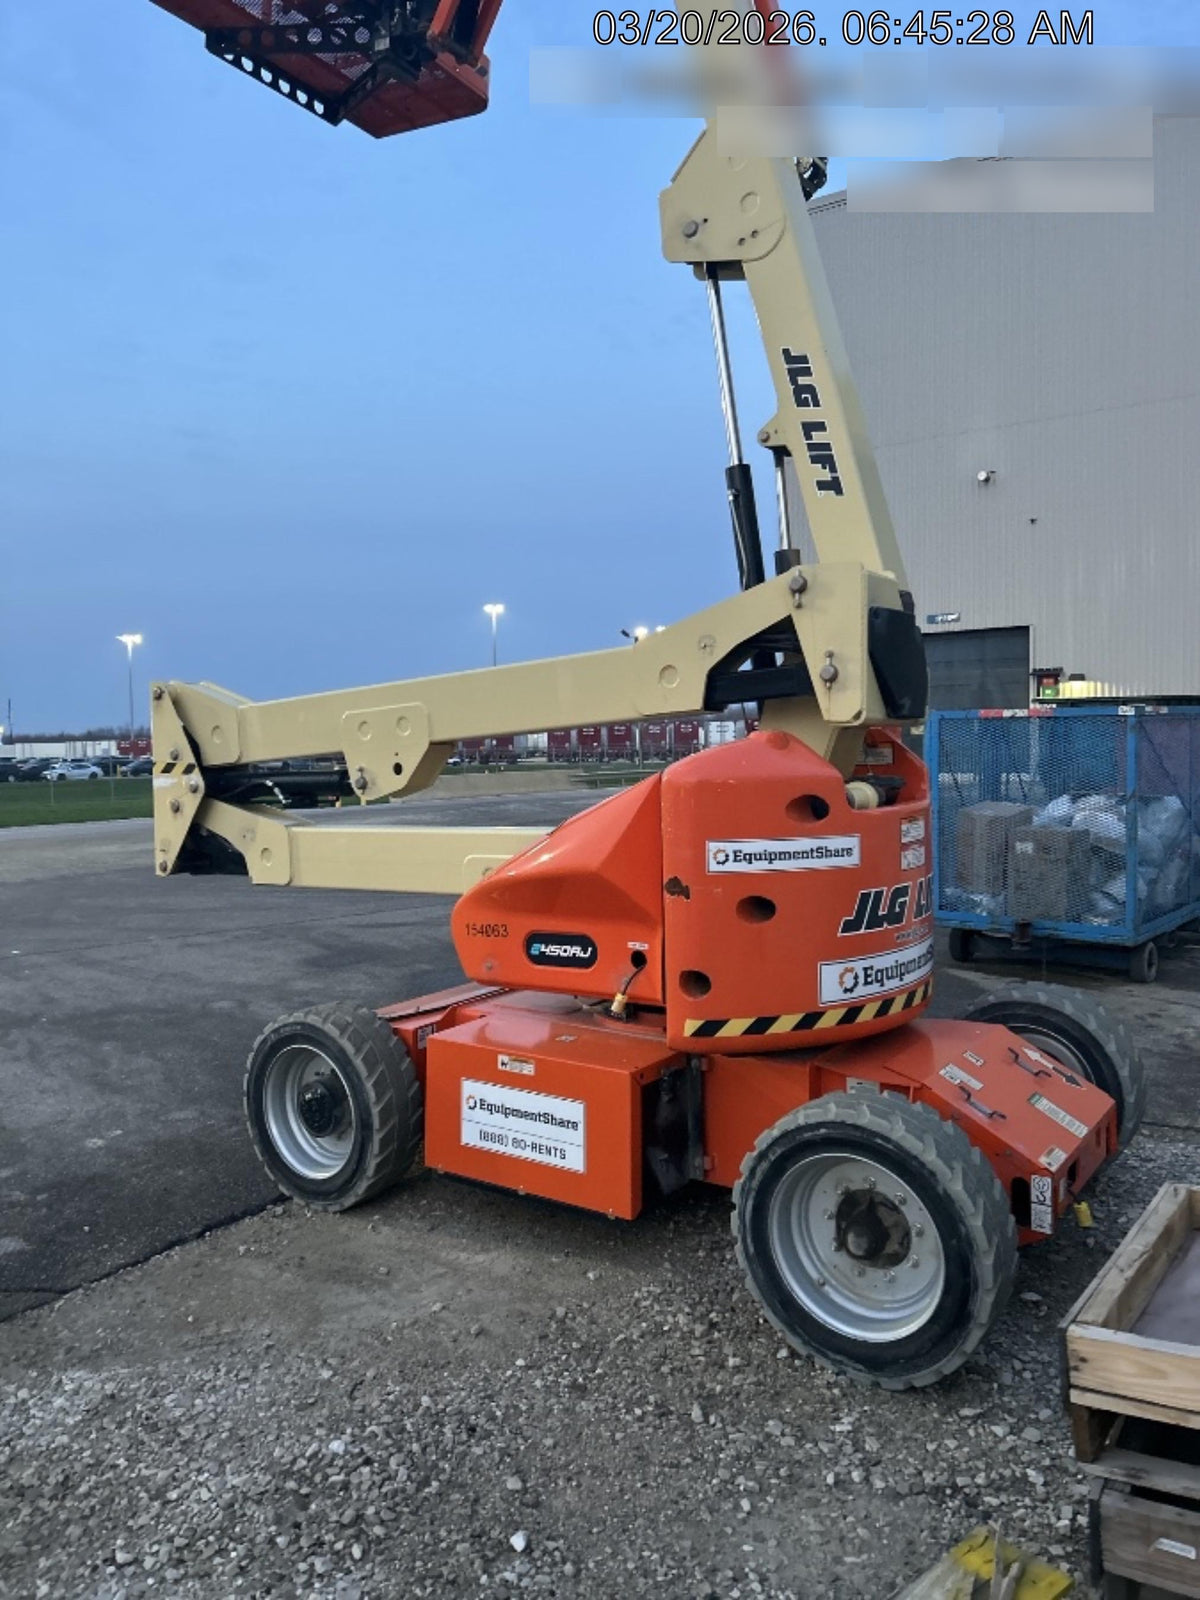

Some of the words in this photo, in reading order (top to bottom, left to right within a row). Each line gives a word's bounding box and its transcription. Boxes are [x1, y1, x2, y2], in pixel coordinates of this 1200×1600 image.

[781, 347, 821, 409] JLG
[800, 420, 844, 496] LIFT
[732, 847, 854, 865] EquipmentShare
[465, 923, 509, 938] 154063
[837, 882, 912, 936] JLG
[479, 1098, 579, 1131] EquipmentShare
